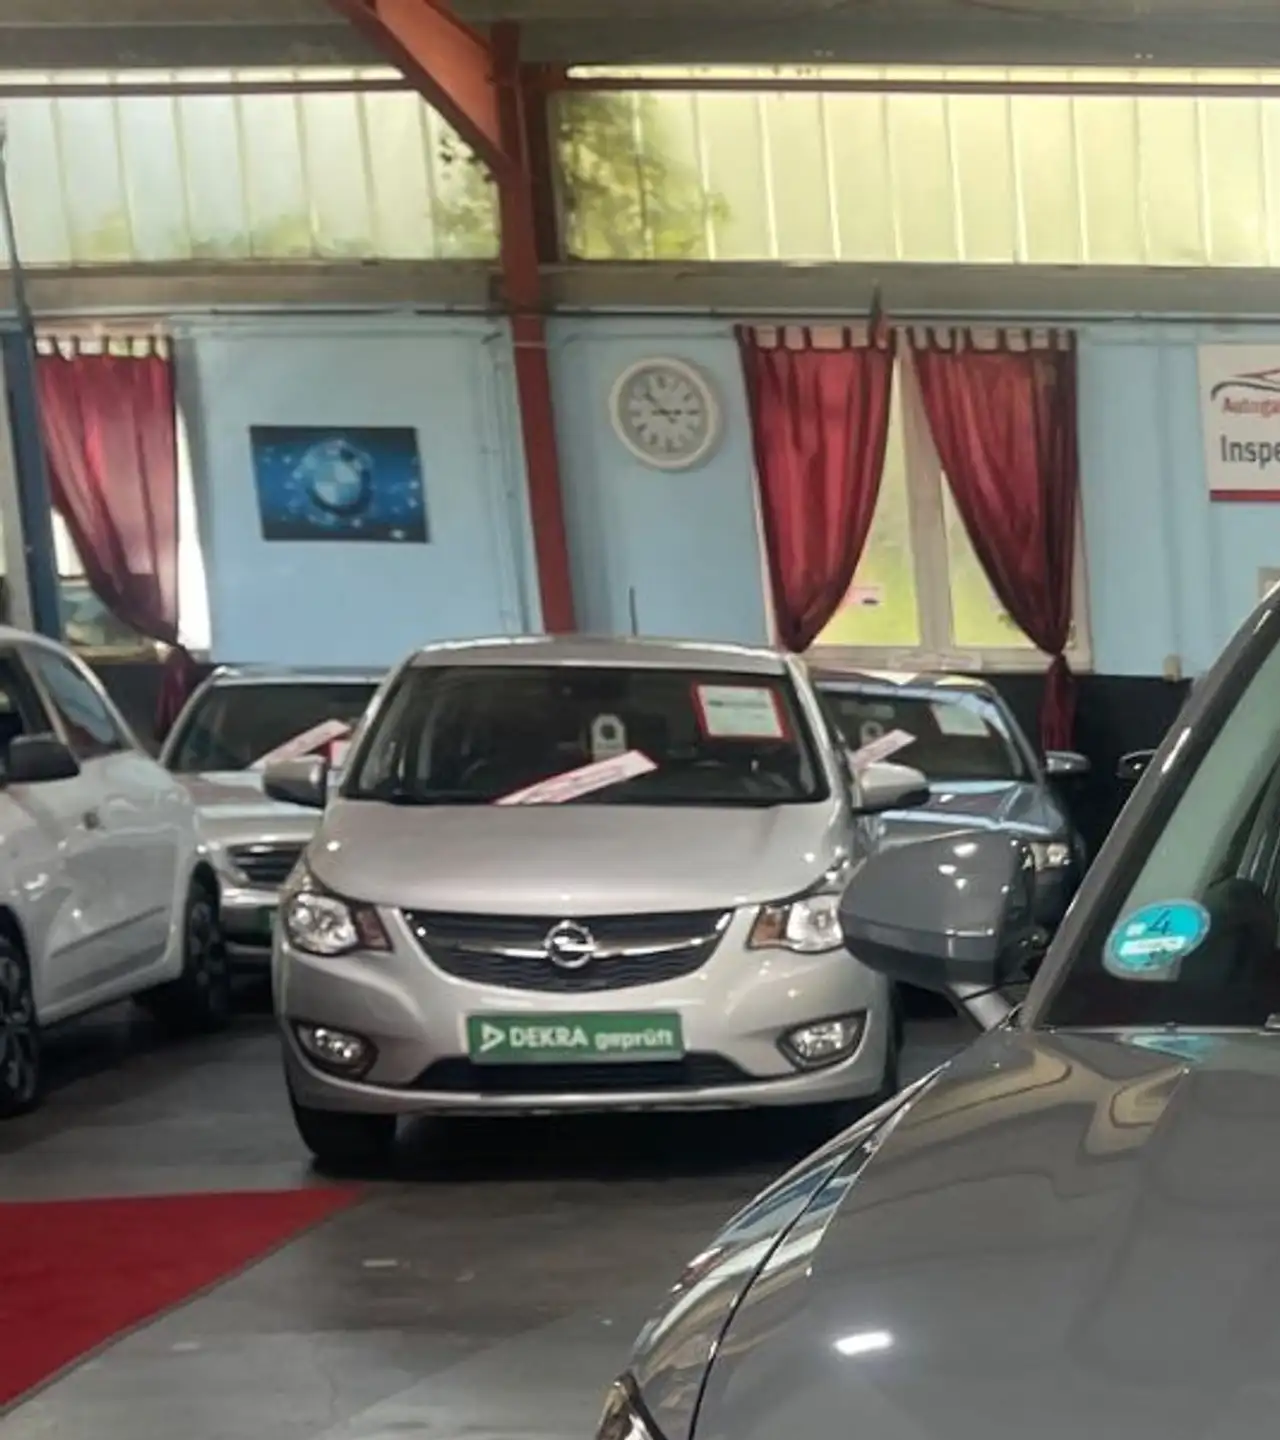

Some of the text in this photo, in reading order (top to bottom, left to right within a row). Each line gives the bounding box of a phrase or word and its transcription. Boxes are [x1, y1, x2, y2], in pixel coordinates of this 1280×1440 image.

[1147, 907, 1173, 936] 4
[509, 1025, 674, 1051] DEKRA geprüft
